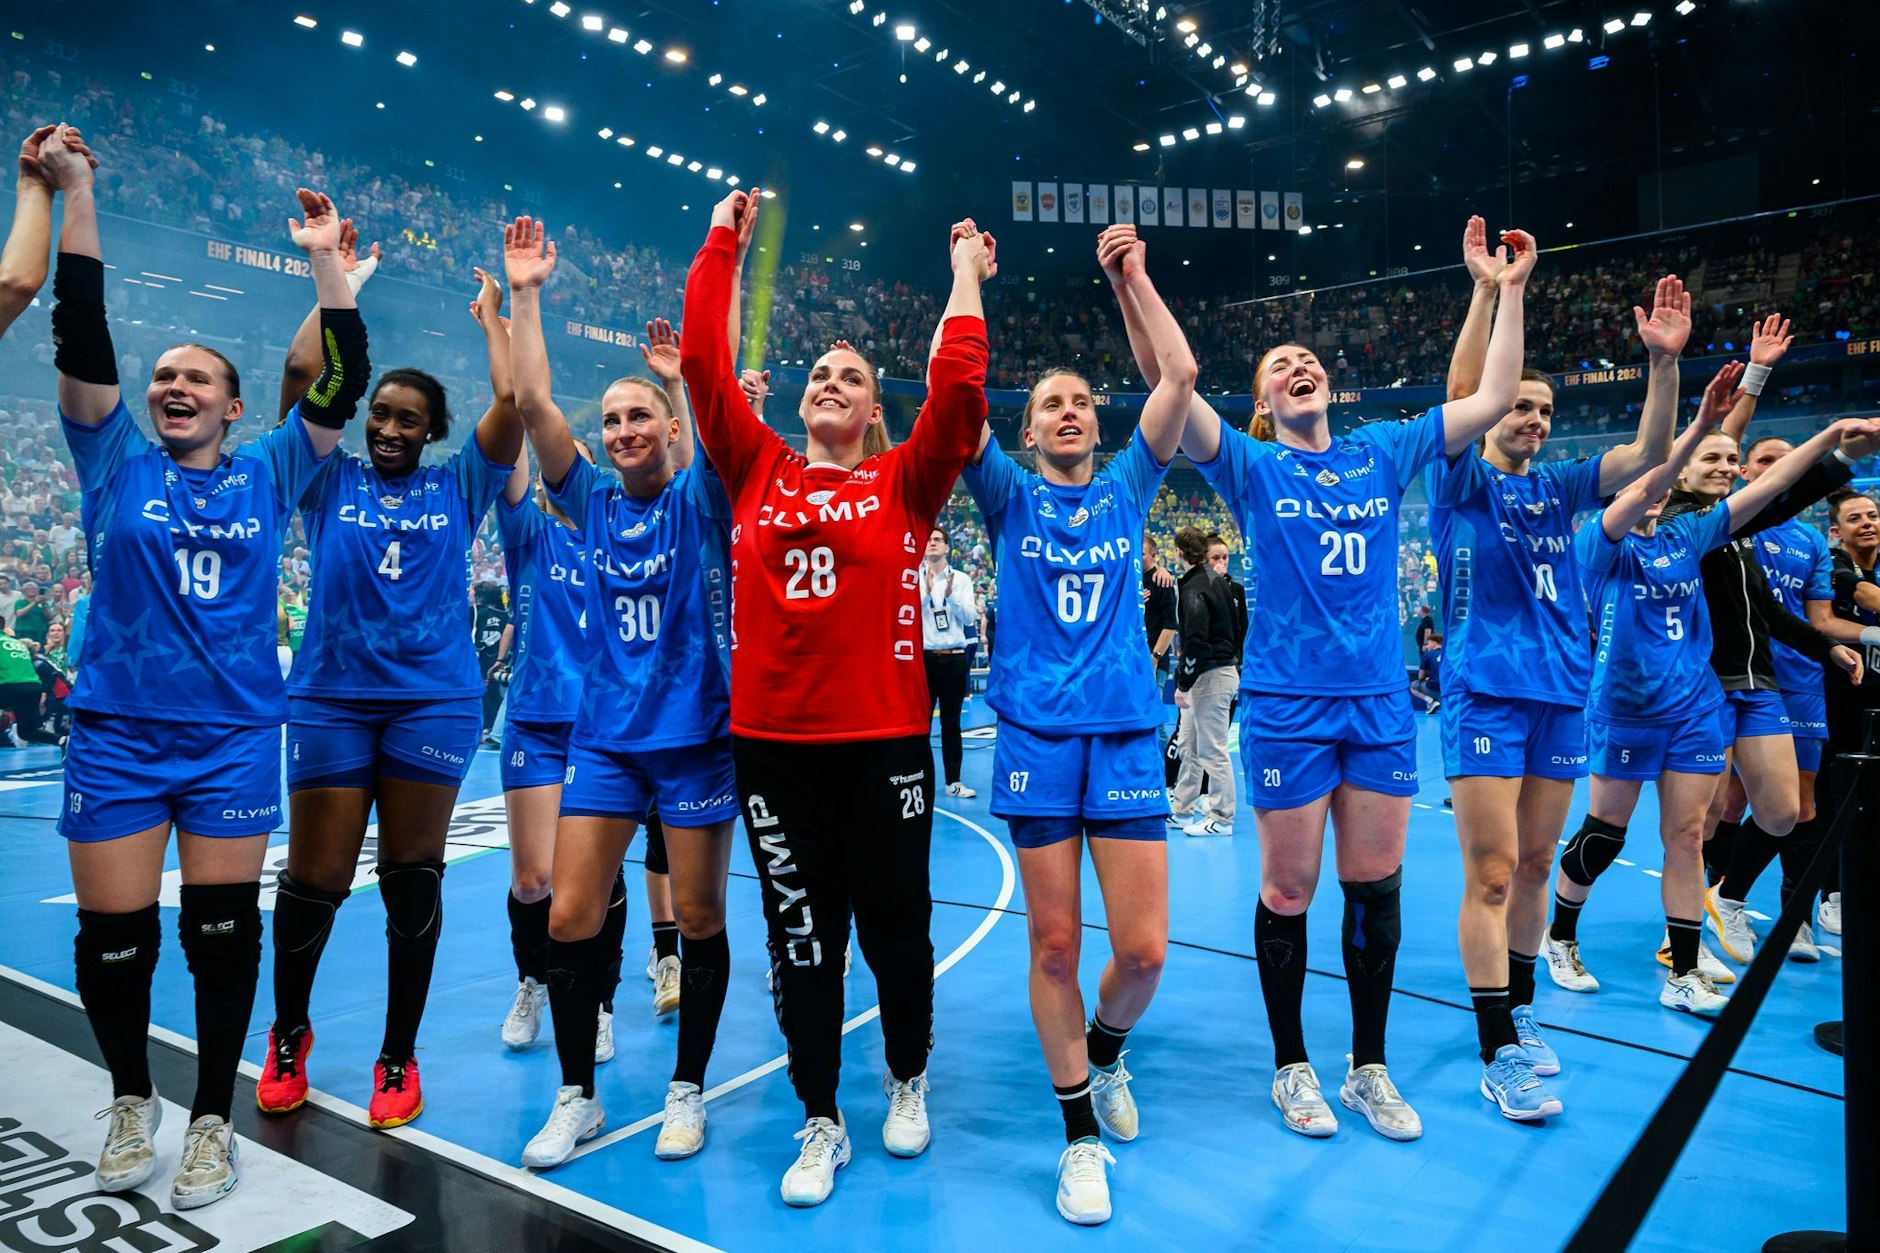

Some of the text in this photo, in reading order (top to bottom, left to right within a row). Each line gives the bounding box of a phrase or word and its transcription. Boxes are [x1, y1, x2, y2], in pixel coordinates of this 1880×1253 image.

[207, 240, 314, 279] EHF FINAL4 202
[841, 258, 861, 271] 310
[1268, 274, 1291, 287] 309
[566, 320, 637, 348] EHF FINAL4 2024
[1847, 340, 1868, 356] EHF
[1564, 367, 1642, 386] EHF FINAL4 2024
[1340, 391, 1361, 404] 2024
[142, 499, 261, 540] OYMP
[1275, 497, 1389, 522] OLYMP
[1500, 521, 1571, 554] OYM
[378, 541, 403, 581] 4
[1021, 535, 1130, 566] OLYMP
[1319, 530, 1367, 577] 20
[174, 548, 222, 600] 19
[784, 546, 837, 600] 28
[1762, 565, 1804, 590] YMP
[1057, 573, 1105, 623] 67
[615, 594, 661, 642] 30
[1665, 606, 1684, 641] 5
[421, 745, 465, 765] OLYMP
[1473, 736, 1491, 754] 10
[511, 751, 525, 767] 48
[1551, 755, 1588, 765] OLYMP
[1620, 749, 1630, 764] 5
[899, 769, 925, 784] hummel
[1009, 771, 1029, 793] 67
[1263, 768, 1281, 787] 20
[69, 792, 83, 814] 19
[678, 794, 733, 811] OLYMP
[900, 785, 925, 820] 28
[1107, 789, 1161, 800] OLYMP
[222, 805, 278, 820] OLYMP
[748, 794, 823, 967] OLYMP
[201, 919, 235, 932] SELECT
[101, 946, 138, 961] SELECT
